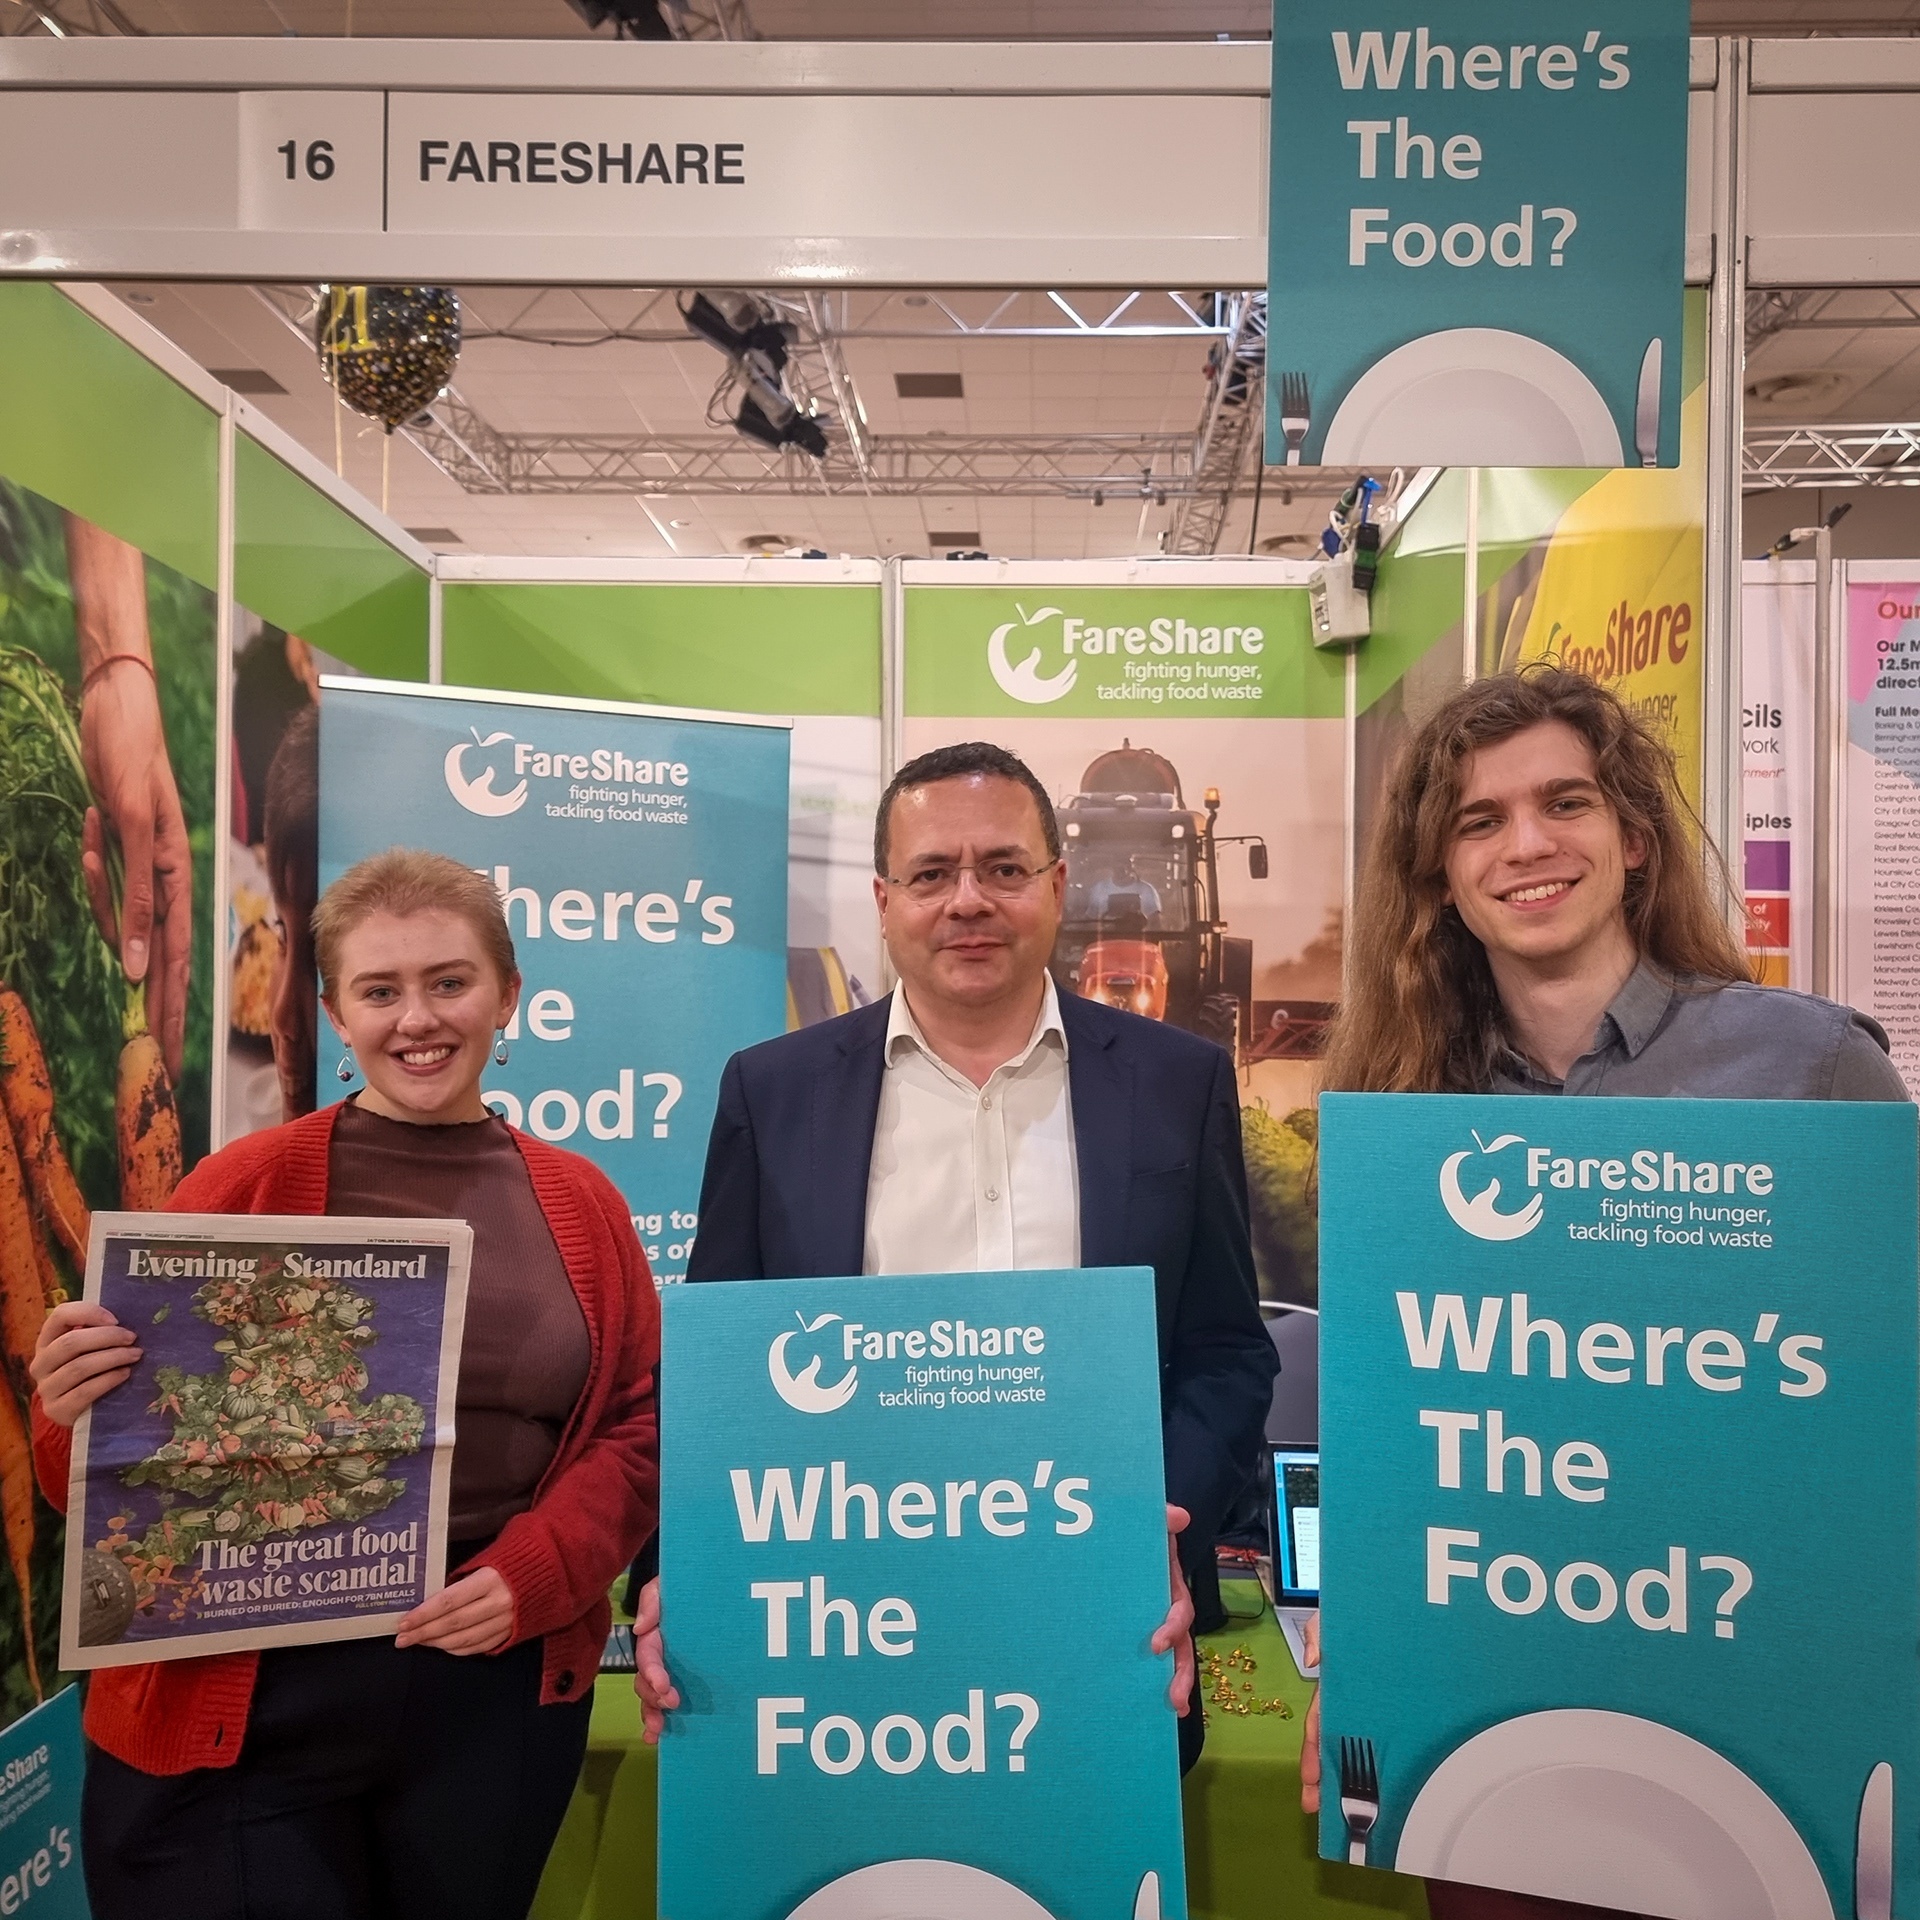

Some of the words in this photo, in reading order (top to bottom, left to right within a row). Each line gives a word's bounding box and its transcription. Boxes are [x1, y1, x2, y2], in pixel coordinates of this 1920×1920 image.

[1331, 27, 1631, 91] Where's
[277, 139, 335, 181] 16
[420, 140, 746, 184] FARESHARE
[1347, 116, 1483, 179] The
[1348, 204, 1578, 268] Food?
[1062, 617, 1264, 655] FareShare
[1877, 640, 1905, 653] Our
[1096, 682, 1163, 704] tackling
[1167, 682, 1208, 700] food
[1211, 685, 1263, 700] waste
[1123, 661, 1192, 682] fighting
[1195, 661, 1263, 682] hunger,
[1875, 706, 1896, 717] Full
[515, 743, 689, 787] FareShare
[545, 802, 605, 824] tackling
[607, 805, 642, 822] food
[645, 810, 688, 824] waste
[568, 784, 629, 806] fighting
[631, 787, 688, 810] hunger,
[473, 865, 736, 945] here's
[480, 1068, 683, 1142] ood?
[1527, 1147, 1775, 1196] FareShare
[669, 1210, 698, 1229] to
[1600, 1198, 1683, 1226] fighting
[1688, 1202, 1772, 1226] hunger,
[1567, 1222, 1648, 1248] tackling
[1653, 1224, 1704, 1246] food
[1709, 1229, 1773, 1249] waste
[126, 1248, 258, 1286] Evening
[283, 1252, 427, 1279] Standard
[843, 1320, 1045, 1361] FareShare
[1395, 1291, 1827, 1398] Where's
[905, 1365, 974, 1387] fighting
[978, 1363, 1045, 1385] hunger,
[878, 1389, 946, 1409] tackling
[949, 1387, 990, 1405] food
[994, 1386, 1046, 1404] waste
[1419, 1409, 1609, 1503] The
[731, 1460, 1094, 1543] Where's
[196, 1538, 257, 1572] The
[262, 1530, 344, 1573] great
[351, 1521, 418, 1557] food
[202, 1572, 293, 1606] waste
[298, 1555, 416, 1596] scandal
[1426, 1526, 1753, 1639] Food?
[204, 1606, 245, 1619] BURNED
[246, 1604, 261, 1613] OR
[261, 1602, 301, 1612] BURIED:
[302, 1597, 344, 1609] ENOUGH
[345, 1594, 365, 1604] FOR
[384, 1588, 416, 1599] MEALS
[750, 1575, 917, 1658] The
[756, 1689, 1040, 1775] Food?
